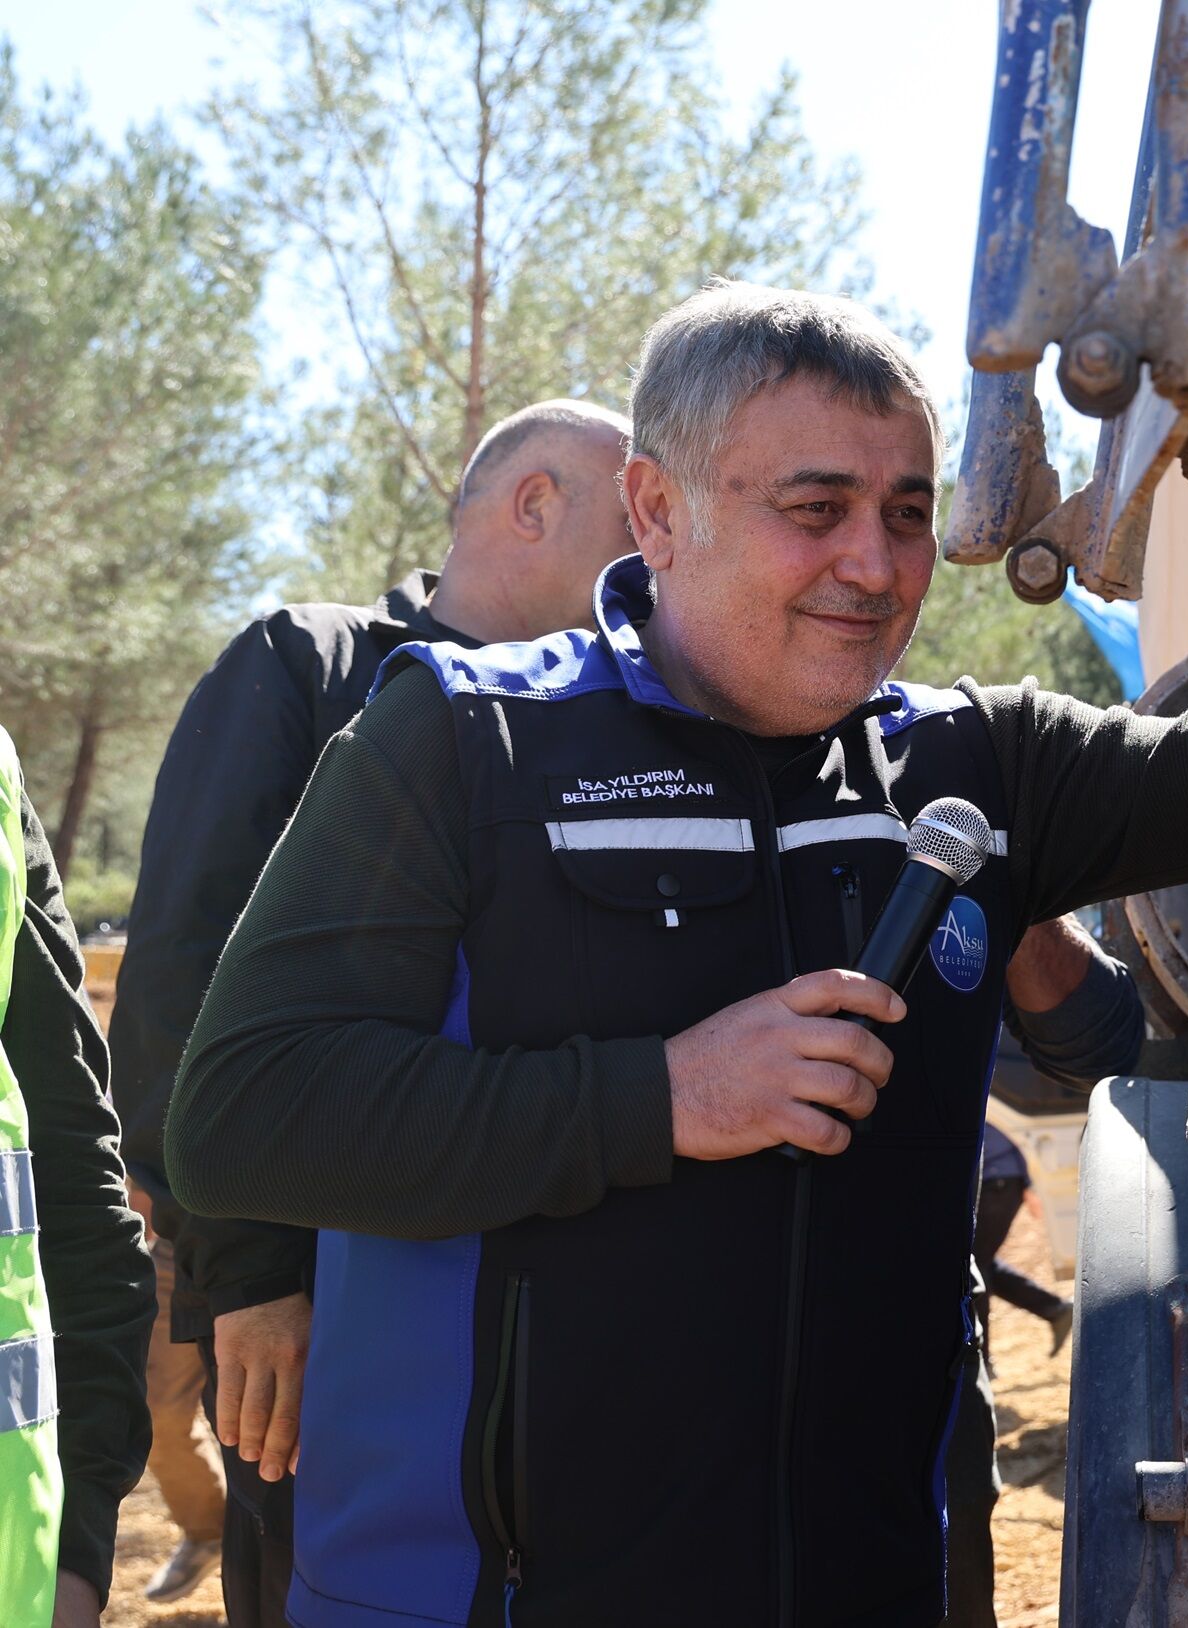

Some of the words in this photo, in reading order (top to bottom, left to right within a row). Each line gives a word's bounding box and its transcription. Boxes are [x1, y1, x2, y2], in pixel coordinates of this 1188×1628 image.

[608, 769, 685, 788] YILDIRIM
[562, 788, 638, 804] BELEDİYE
[641, 783, 715, 798] BAŞKANI
[937, 910, 983, 955] Aksu
